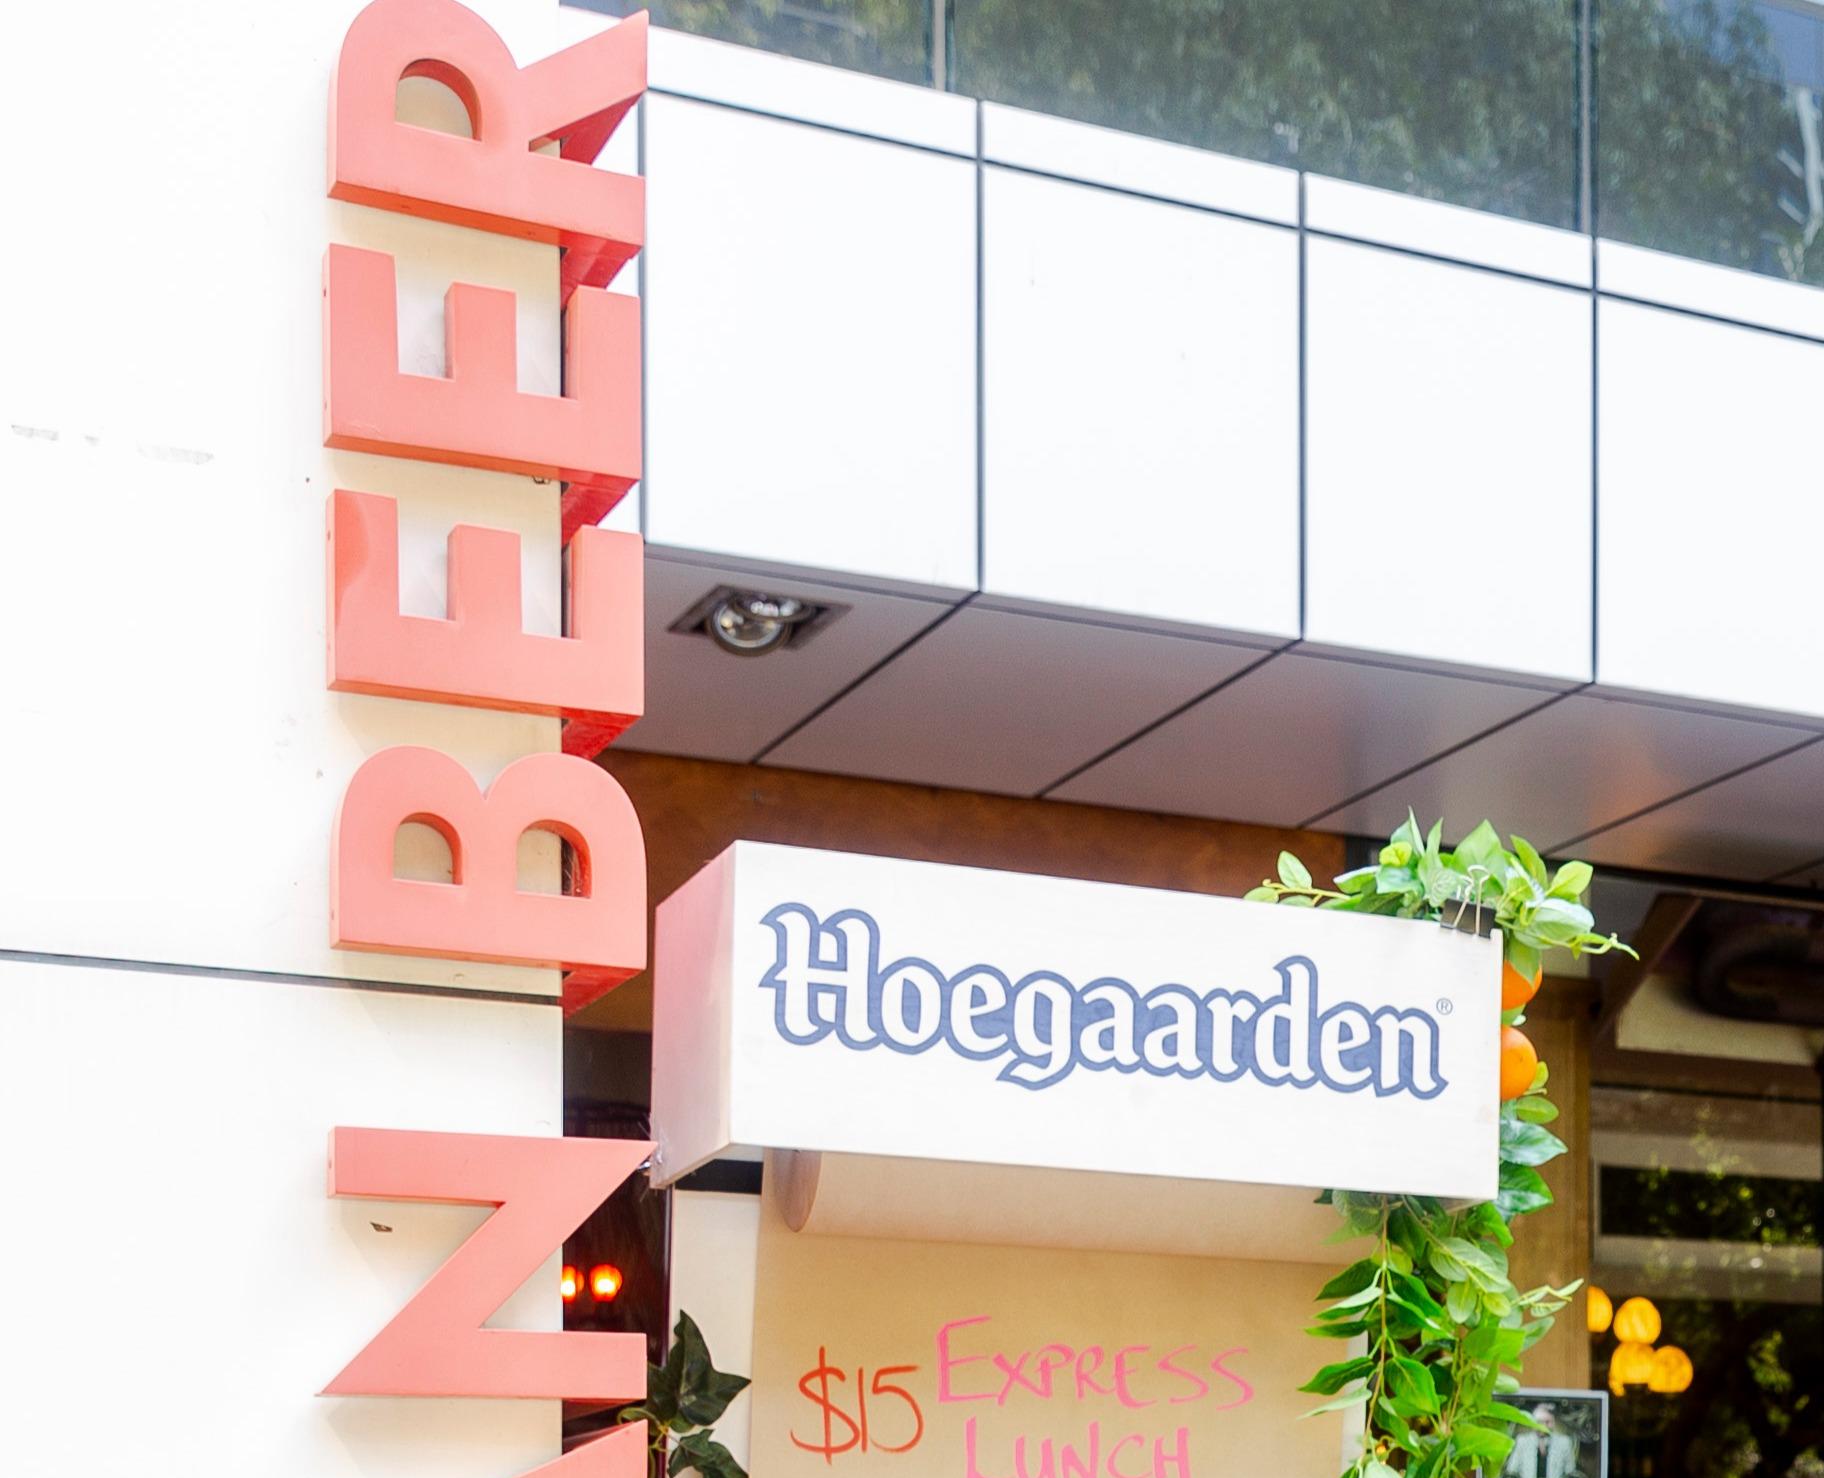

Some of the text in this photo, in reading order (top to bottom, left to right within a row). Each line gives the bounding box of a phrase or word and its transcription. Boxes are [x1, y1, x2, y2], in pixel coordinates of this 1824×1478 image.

[324, 0, 649, 972] BEER
[758, 901, 1448, 1100] Hoegaarden
[790, 1345, 925, 1466] $15
[935, 1314, 1255, 1412] EXPRESS
